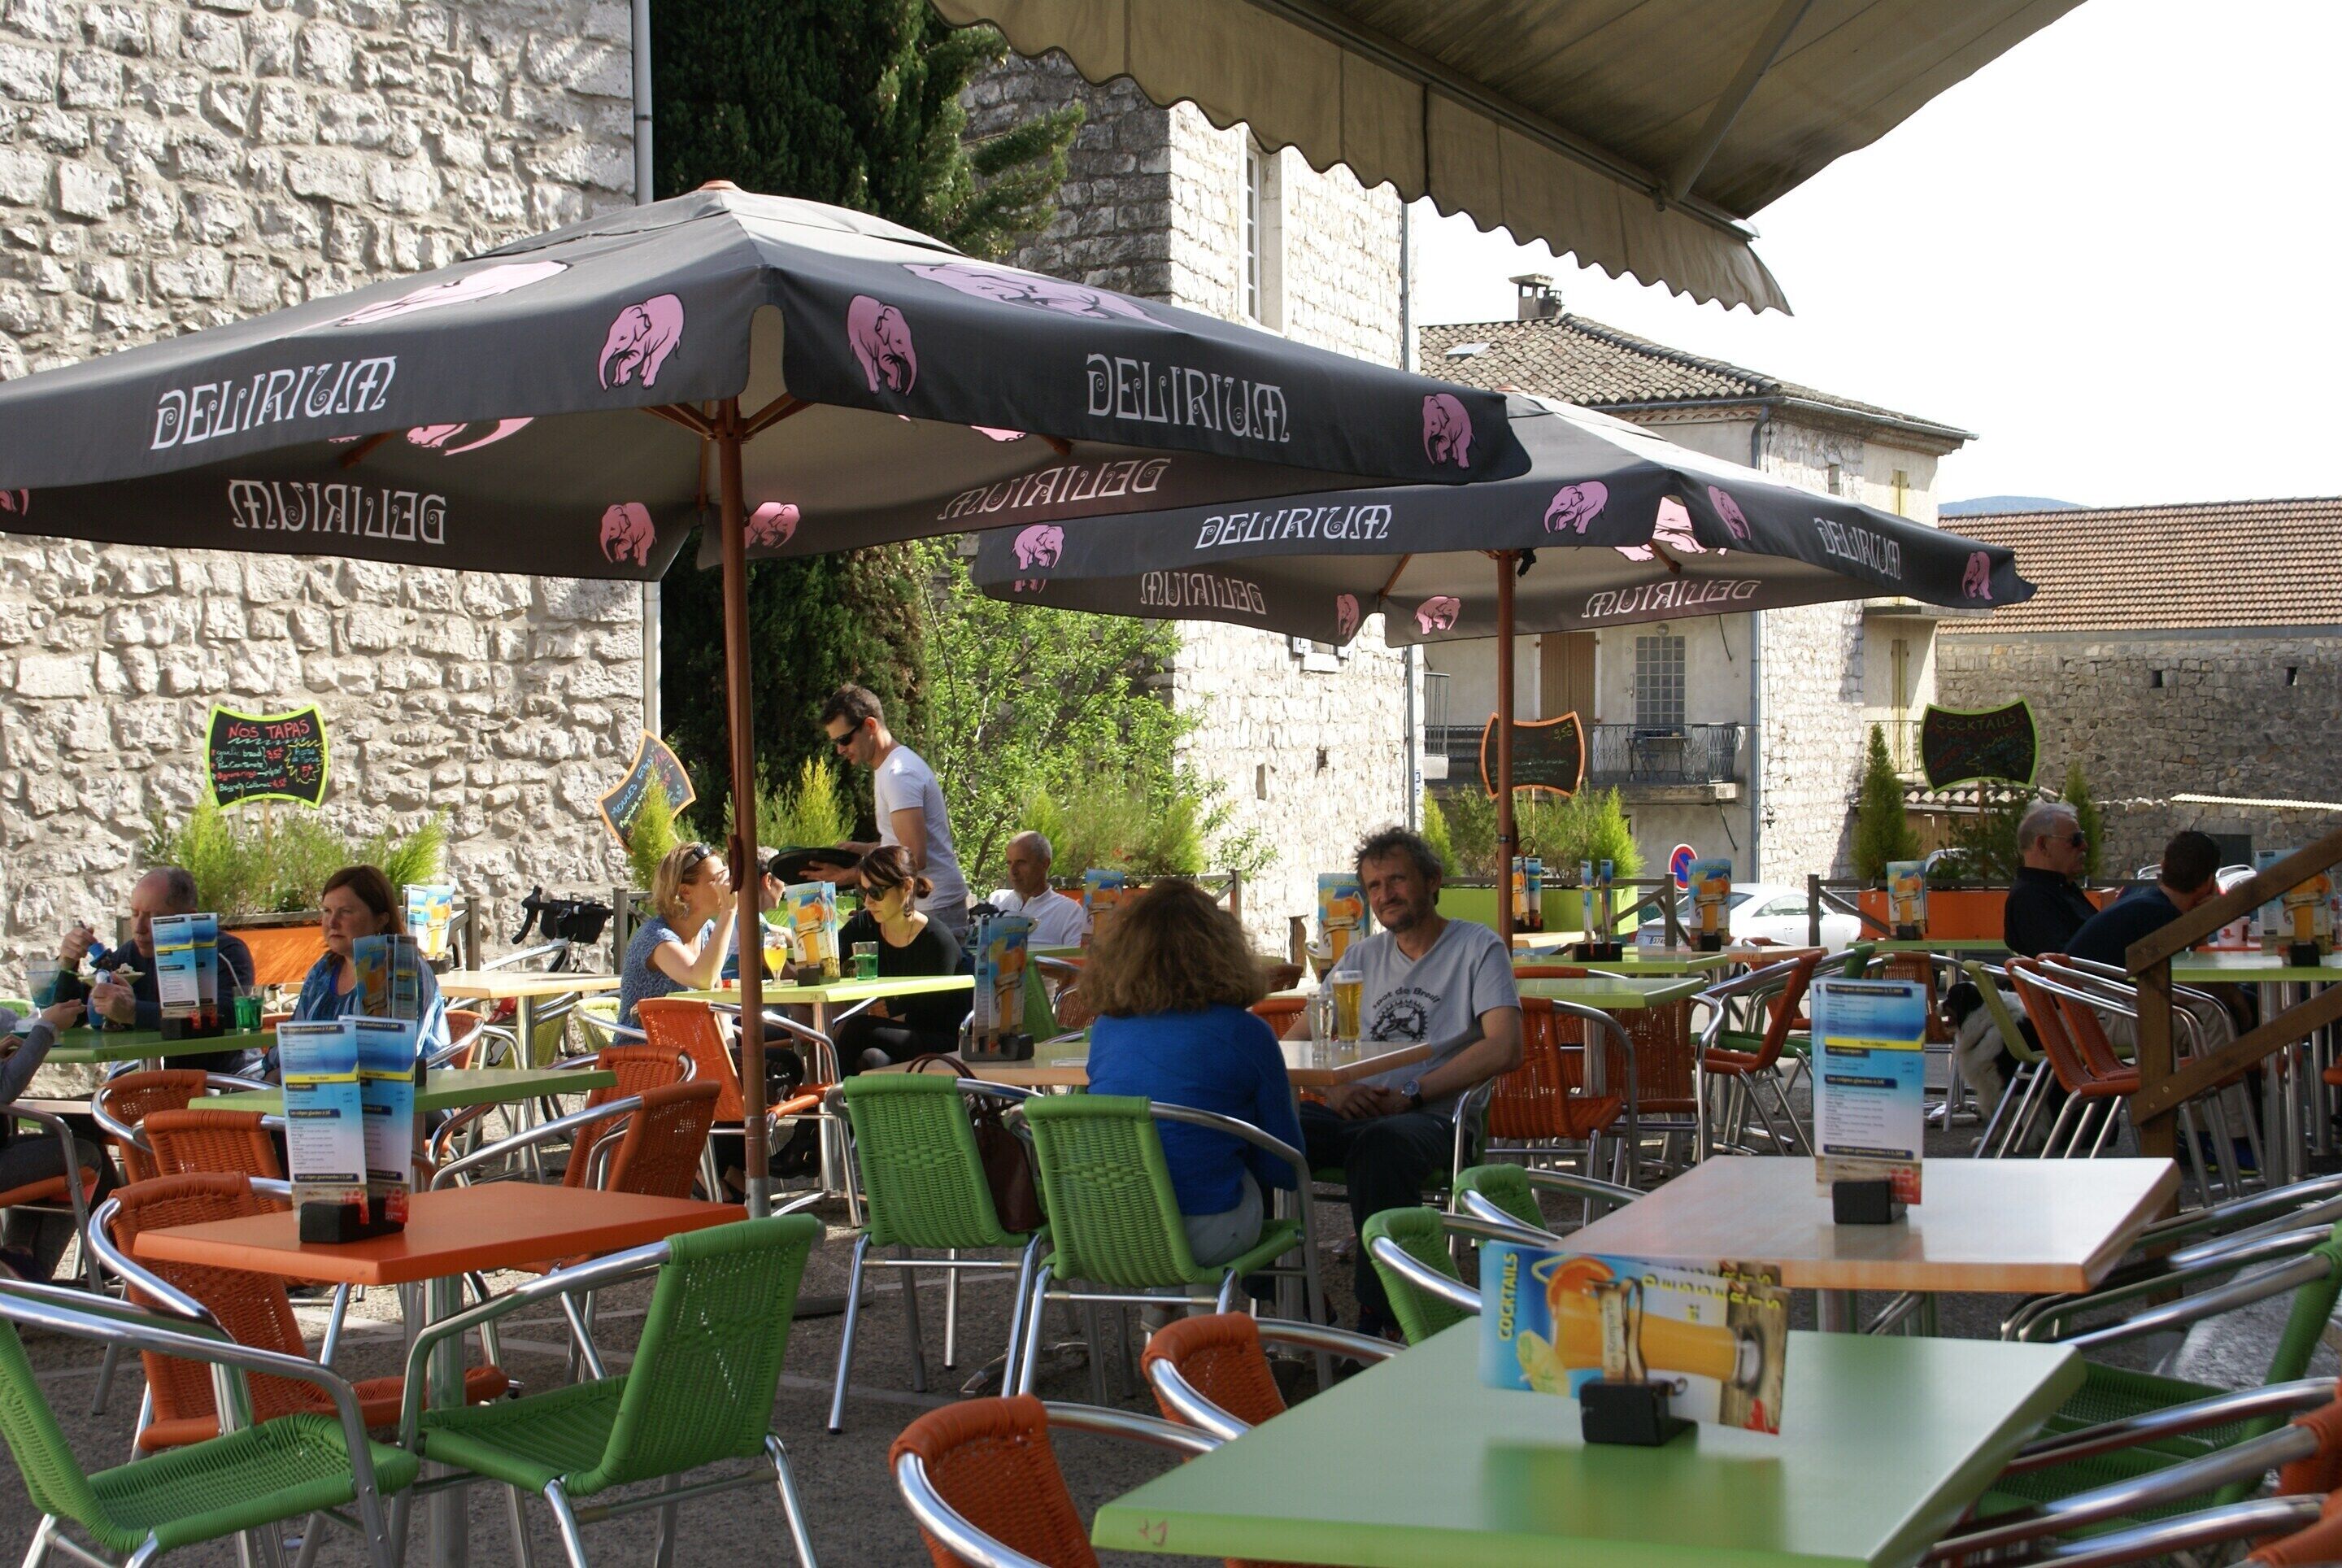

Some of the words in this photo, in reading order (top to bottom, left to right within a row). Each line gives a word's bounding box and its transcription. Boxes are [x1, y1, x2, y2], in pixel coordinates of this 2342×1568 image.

[150, 355, 397, 450] DELIRIUM
[1087, 353, 1291, 443] DELIRIUM
[1195, 504, 1392, 549] DELIRIUM
[1813, 516, 1902, 580] DELIRIUM
[228, 722, 259, 738] NOS
[265, 719, 310, 738] TAPAS
[1936, 713, 2017, 731] COCKTAILS
[611, 785, 638, 817] MOULES
[1497, 1252, 1518, 1341] COCKTAILS
[1641, 1274, 1782, 1310] DESSERTS
